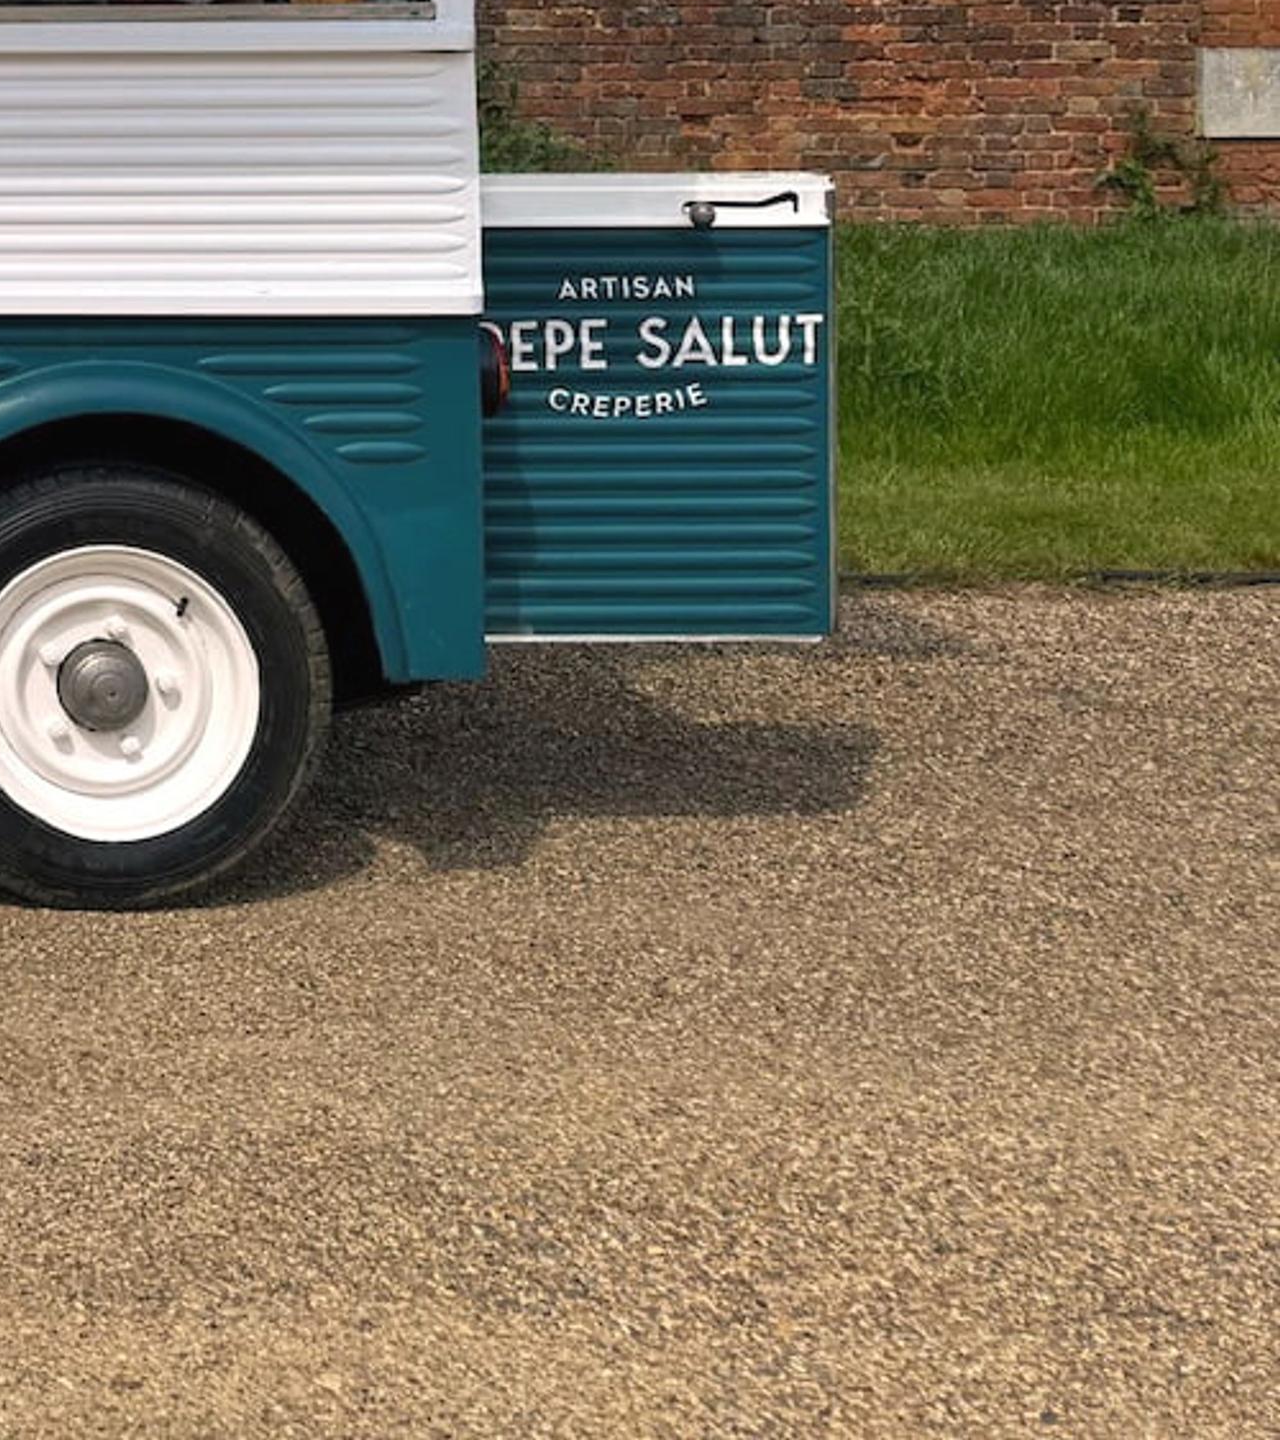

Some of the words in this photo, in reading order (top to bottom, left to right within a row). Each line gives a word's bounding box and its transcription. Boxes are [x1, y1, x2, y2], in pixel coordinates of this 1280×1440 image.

[558, 275, 695, 299] ARTISAN
[479, 318, 608, 371] EPE
[637, 313, 824, 369] SALUT
[548, 382, 708, 418] CREPERIE
